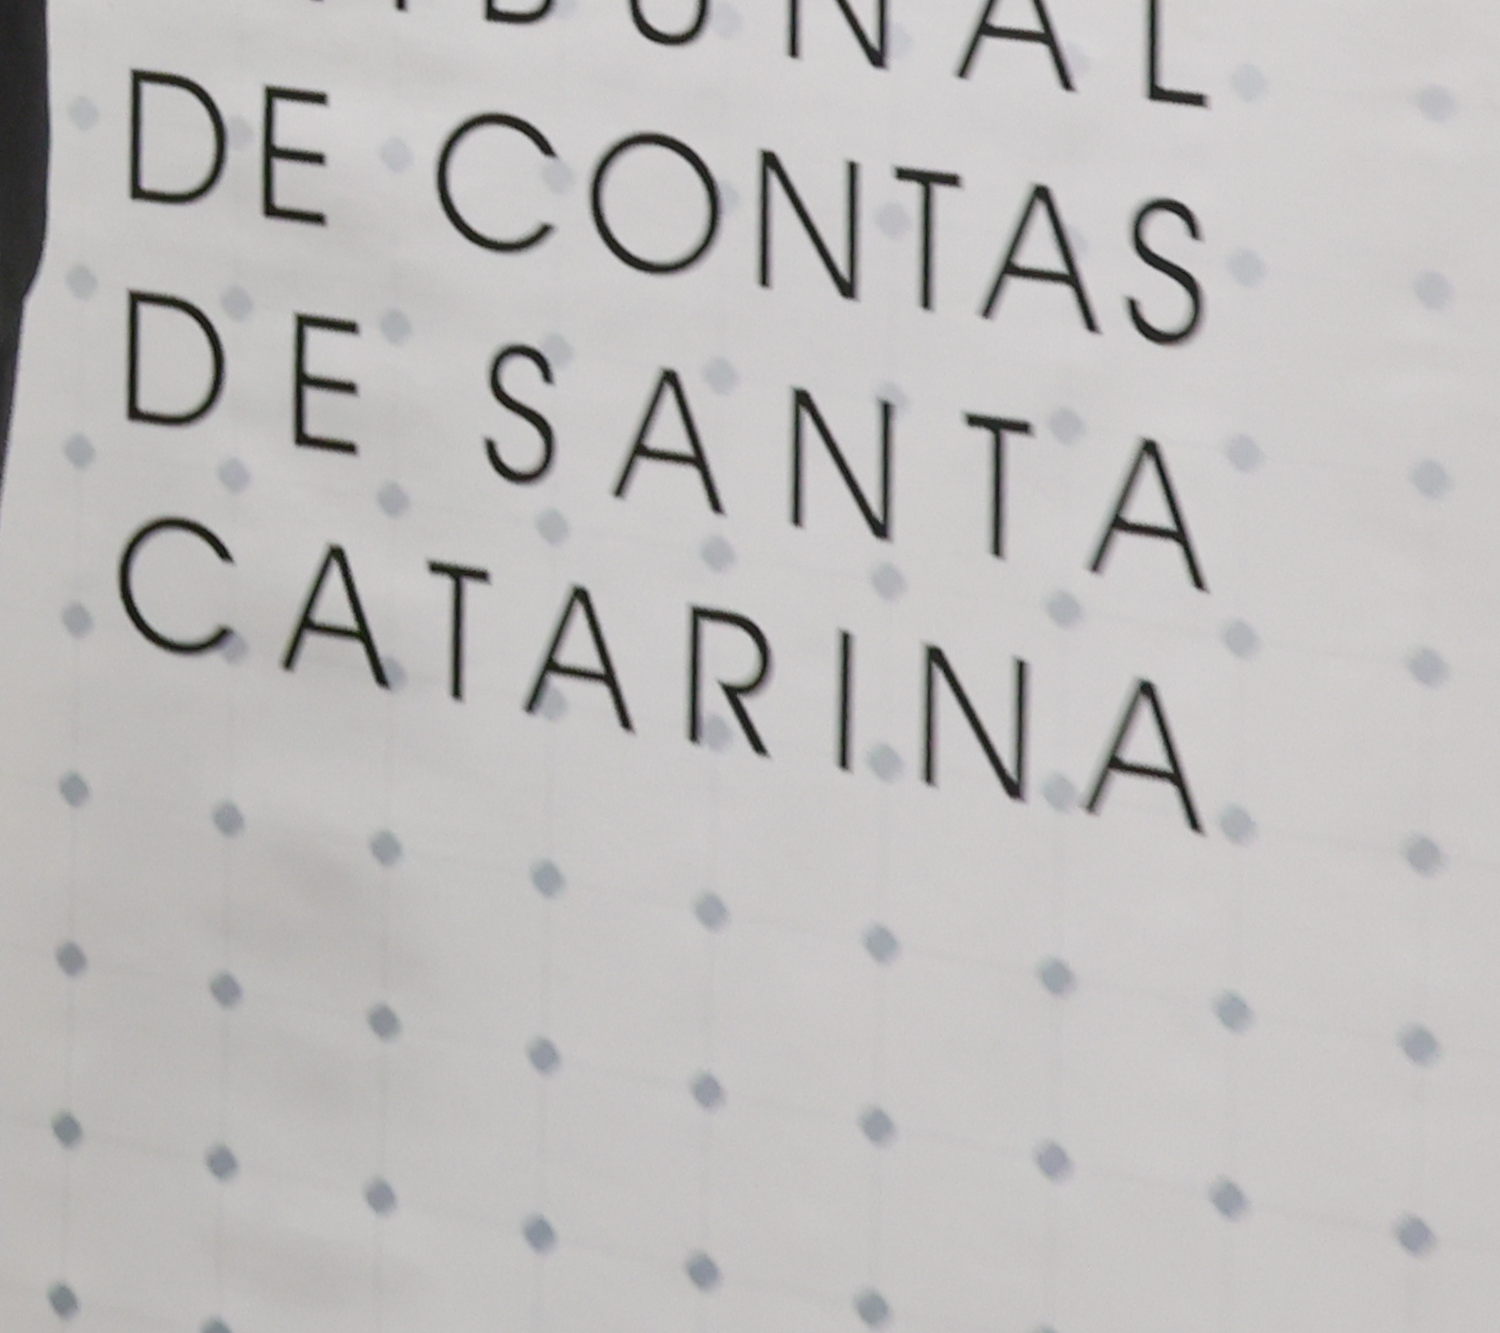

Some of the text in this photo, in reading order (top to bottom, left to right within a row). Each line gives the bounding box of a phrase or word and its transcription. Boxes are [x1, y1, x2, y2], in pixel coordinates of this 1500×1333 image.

[127, 68, 1208, 348] DE CONTAS
[126, 289, 1210, 593] DE SANTA
[116, 514, 1208, 835] CATARINA
